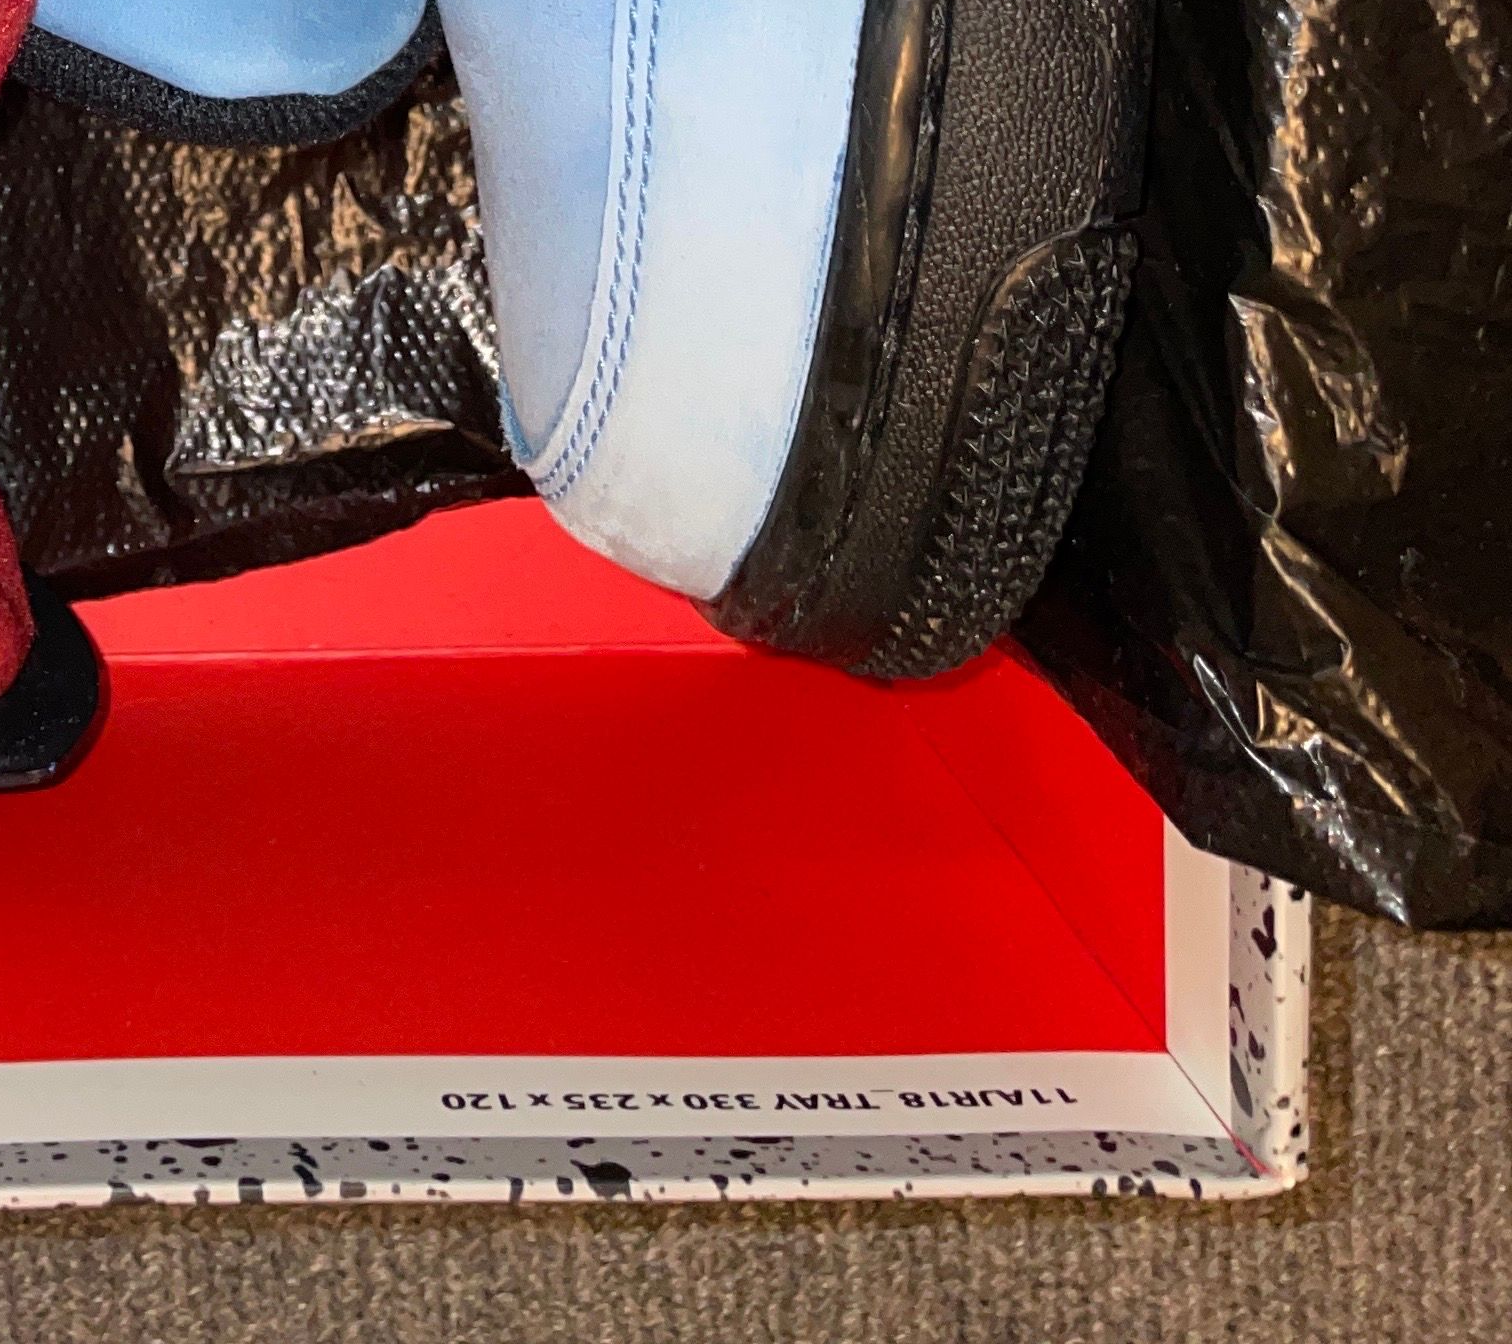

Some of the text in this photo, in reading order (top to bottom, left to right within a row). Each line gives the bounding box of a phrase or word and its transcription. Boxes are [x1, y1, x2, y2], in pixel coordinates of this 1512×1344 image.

[441, 1087, 1079, 1111] 11AJR18_TRAY 330 x 235 x 120
